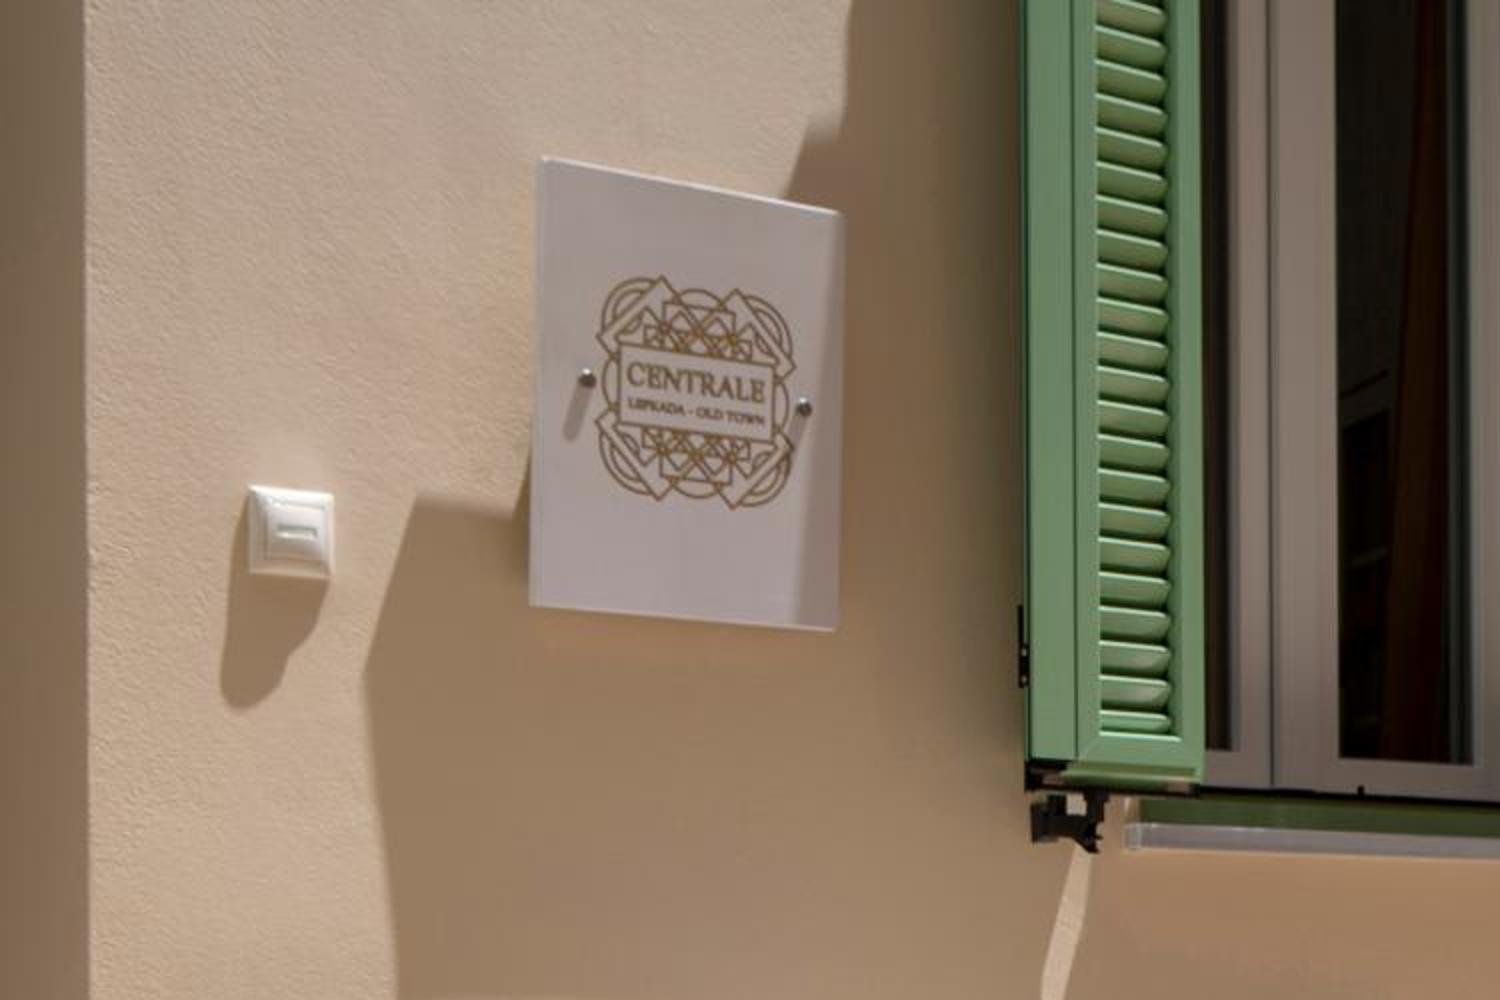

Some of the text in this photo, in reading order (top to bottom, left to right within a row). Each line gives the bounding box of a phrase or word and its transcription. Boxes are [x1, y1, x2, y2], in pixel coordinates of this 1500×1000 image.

[626, 361, 766, 403] CENTRALE
[696, 407, 724, 420] OLD
[726, 411, 765, 425] TOWN
